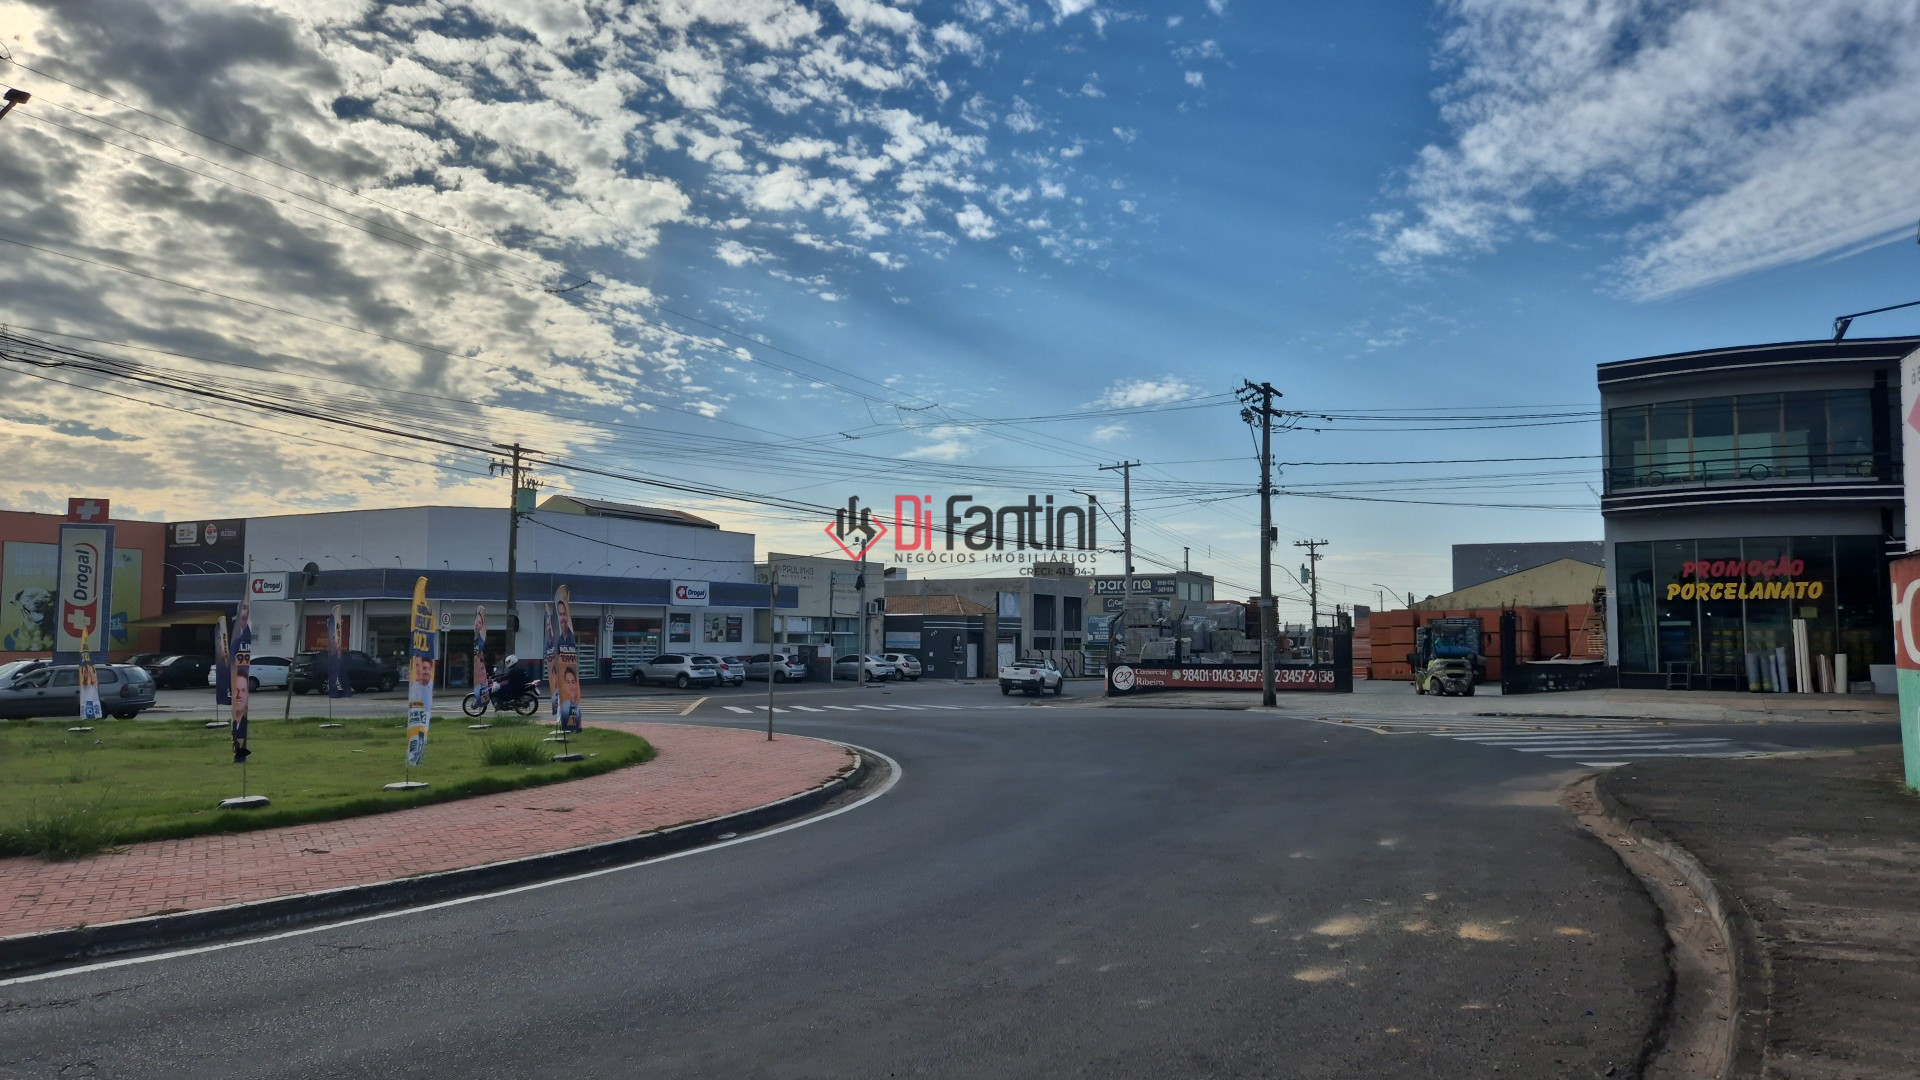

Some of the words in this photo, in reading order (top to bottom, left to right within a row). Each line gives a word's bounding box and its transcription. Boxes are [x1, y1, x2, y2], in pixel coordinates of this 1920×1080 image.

[74, 549, 93, 601] Drogal
[1682, 556, 1805, 581] PROMOÇÃO
[263, 582, 282, 591] Drogal
[687, 588, 705, 597] Drogal
[1667, 582, 1823, 601] PORCELANATO
